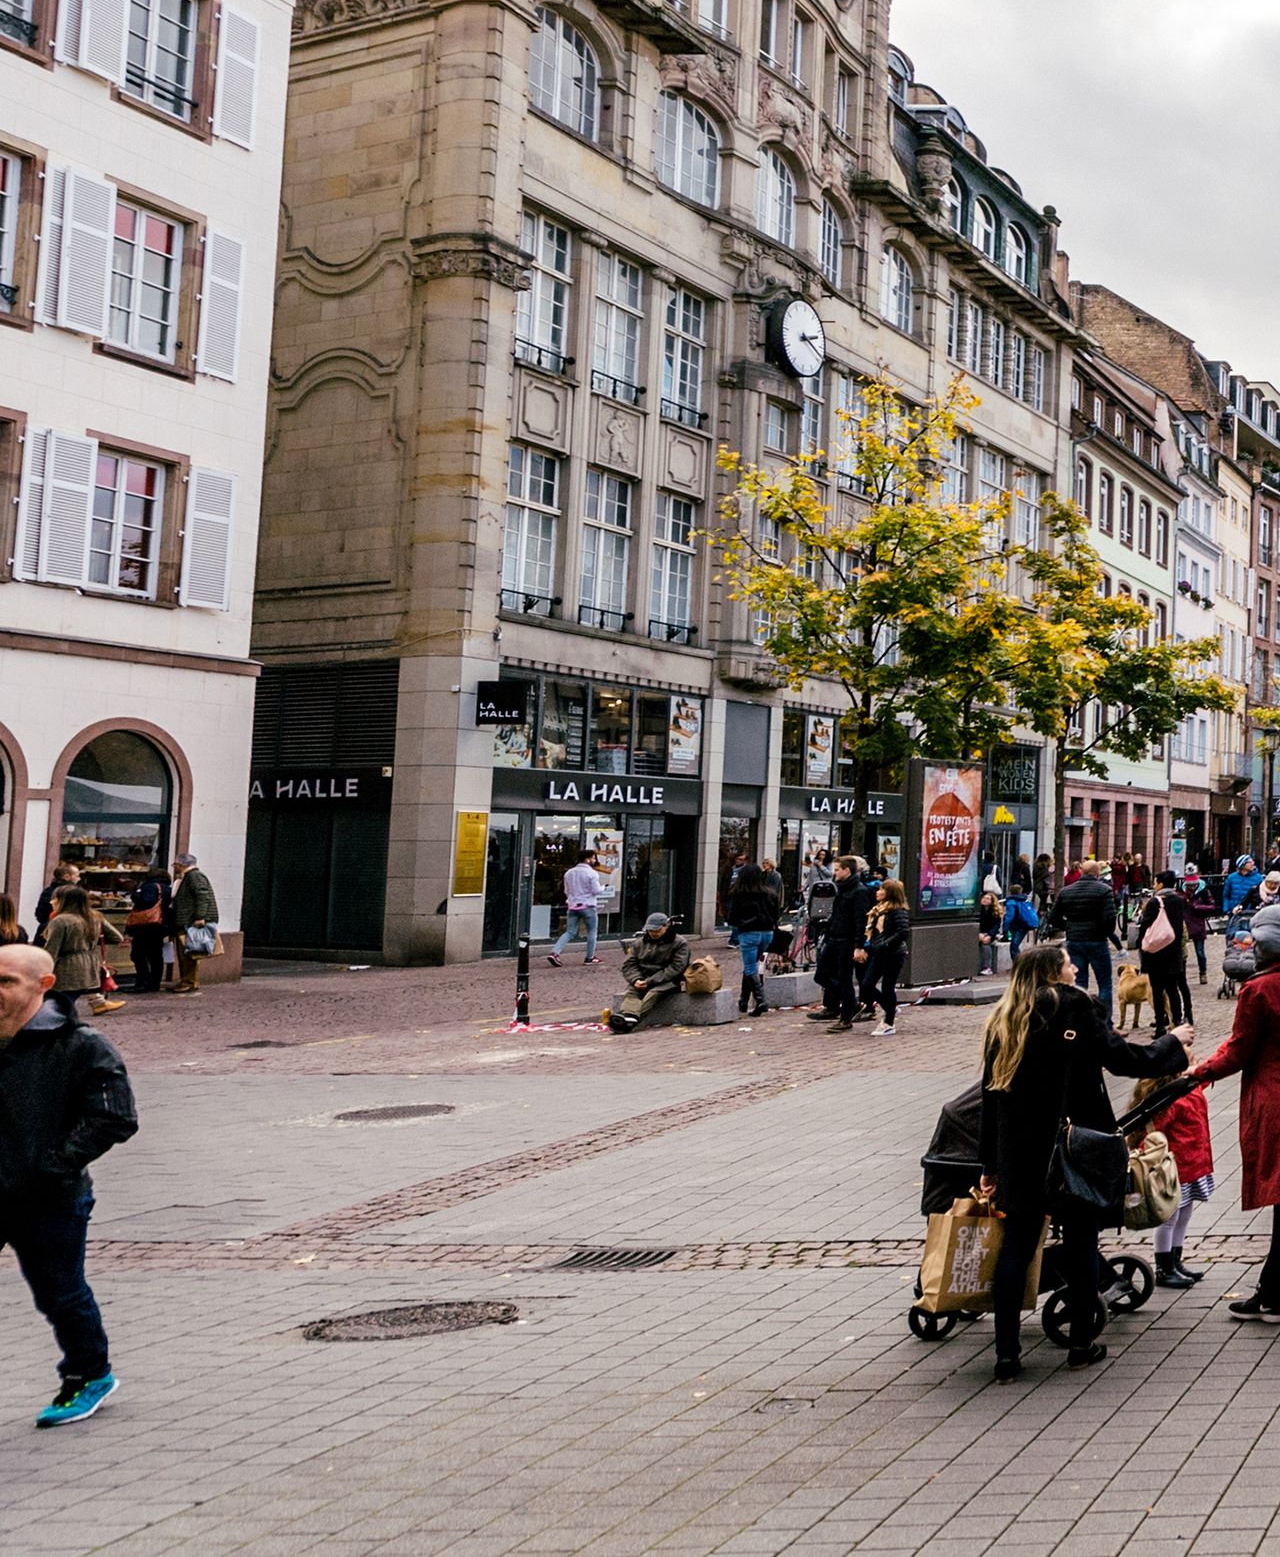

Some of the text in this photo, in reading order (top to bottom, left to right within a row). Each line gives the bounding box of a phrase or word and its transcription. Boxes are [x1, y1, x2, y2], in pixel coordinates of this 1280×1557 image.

[250, 778, 359, 799] A HALLE
[998, 778, 1036, 790] KIDS
[549, 781, 664, 804] LA HALLE
[811, 796, 831, 813] LA
[929, 825, 971, 847] EN FÊTE
[957, 1226, 991, 1238] ONLY
[957, 1237, 983, 1249] THE
[954, 1248, 990, 1260] BEST
[952, 1259, 982, 1271] FOR
[951, 1270, 980, 1282] THE
[947, 1281, 993, 1293] ATHLE
